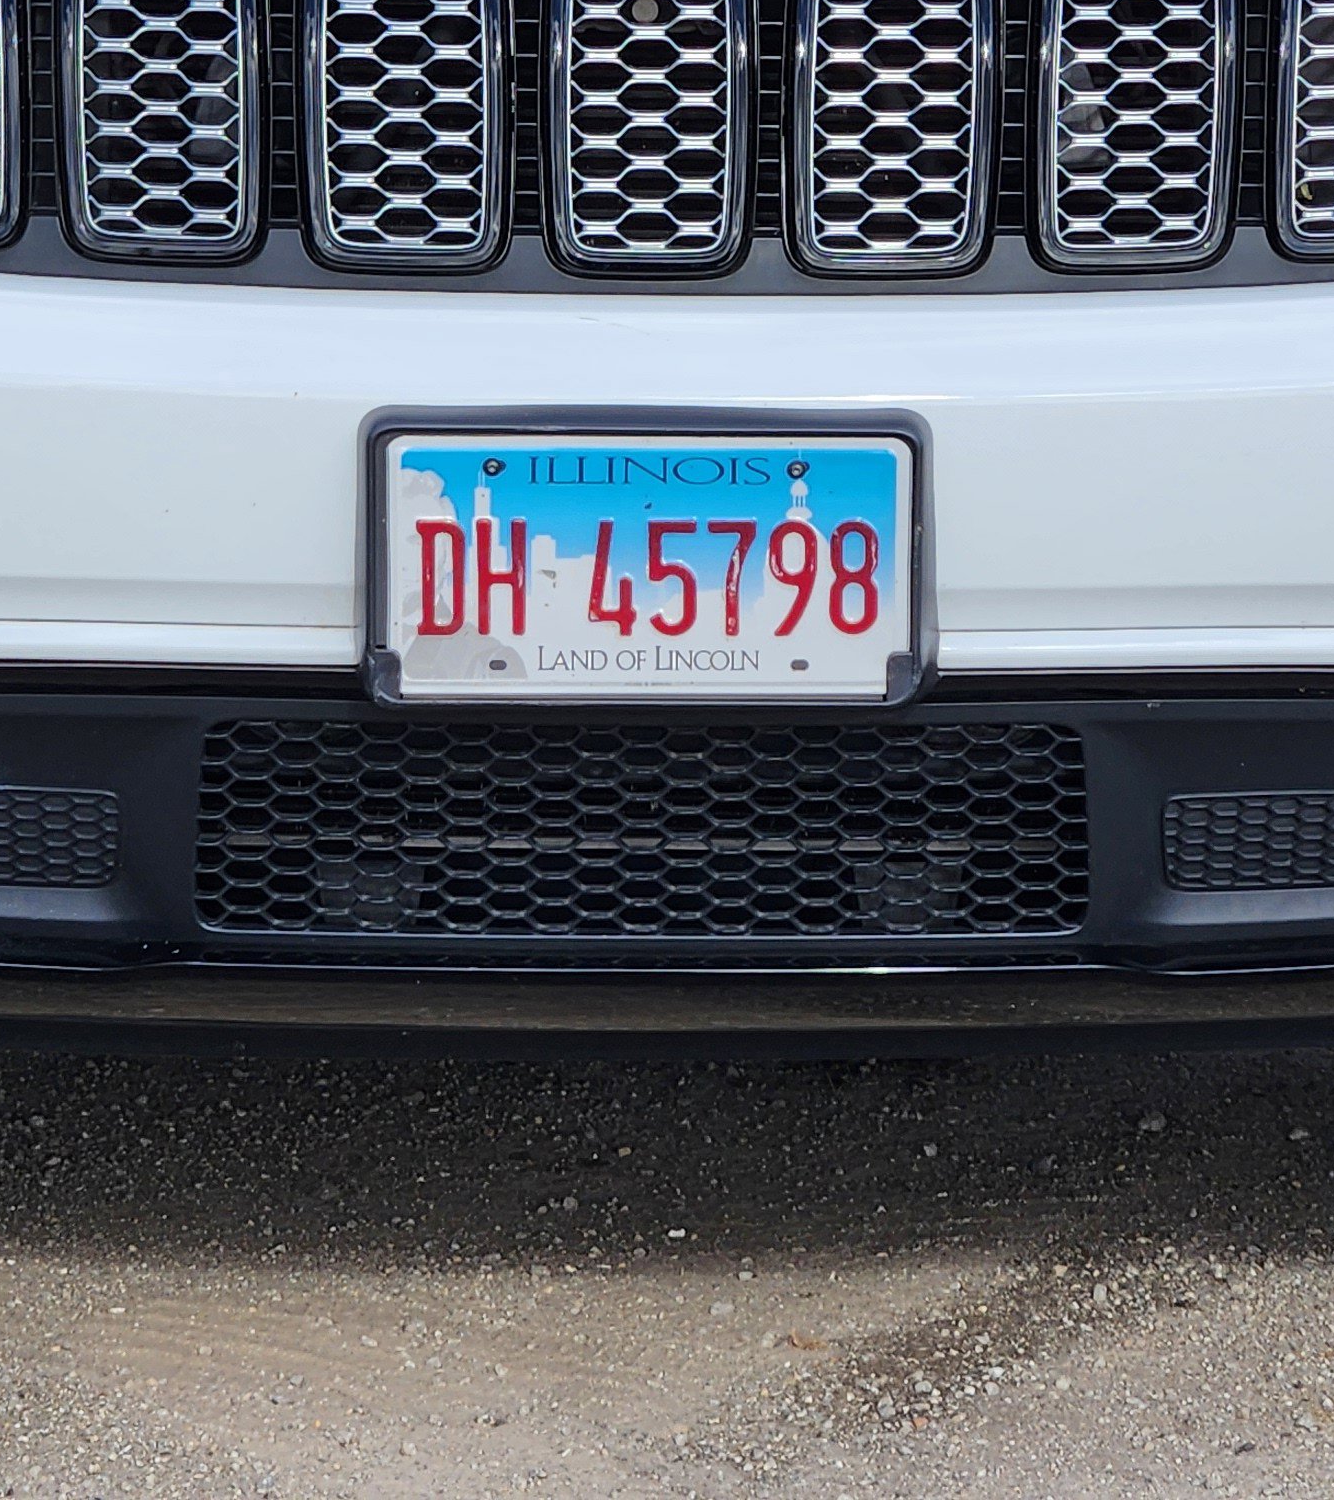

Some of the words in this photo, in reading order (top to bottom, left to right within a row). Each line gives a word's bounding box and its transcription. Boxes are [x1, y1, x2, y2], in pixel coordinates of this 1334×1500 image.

[527, 455, 772, 486] ILLINOIS
[416, 518, 528, 636] DH
[588, 518, 880, 637] 45798
[537, 645, 608, 671] LAND
[615, 649, 647, 671] OF
[655, 645, 760, 671] LINCOLN
